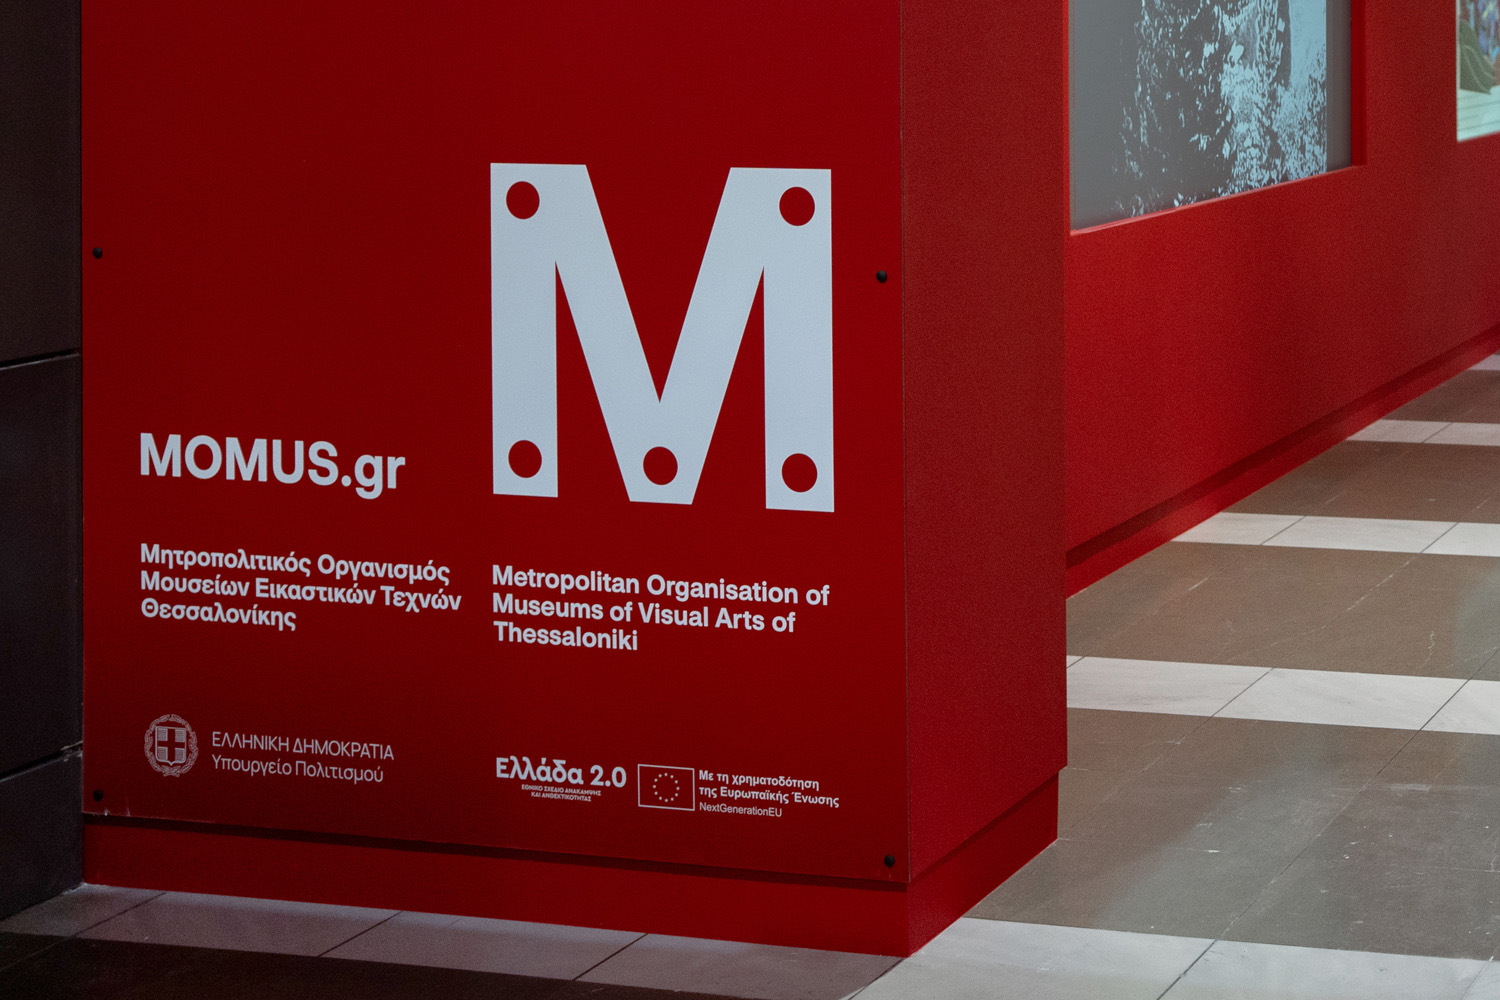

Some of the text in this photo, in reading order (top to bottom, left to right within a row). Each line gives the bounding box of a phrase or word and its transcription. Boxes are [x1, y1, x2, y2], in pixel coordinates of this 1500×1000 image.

[141, 433, 405, 499] MOMUS.gr
[141, 543, 450, 585] Μητροπολιτικός Οργανισμός
[141, 570, 461, 613] Μουσείων Εικαστικών Τεχνών
[493, 565, 830, 605] Metropolitan Organisation of
[141, 597, 297, 631] Θεσσαλονίκης
[493, 593, 795, 632] Museums of Visual Arts of
[493, 621, 637, 650] Thessaloniki
[212, 732, 394, 760] ΕΛΛΗΝΙΚΗ ΔΗΜΟΚΡΑΤΙΑ
[212, 754, 383, 784] Υπουργείο Πολιτισμού
[496, 756, 626, 787] Ελλάδα 2.0
[699, 770, 819, 791] Με τη χρηματοδότηση
[699, 787, 839, 808] της Ευρωπαϊκής Ένωσης
[699, 802, 782, 817] NextGenerationEU
